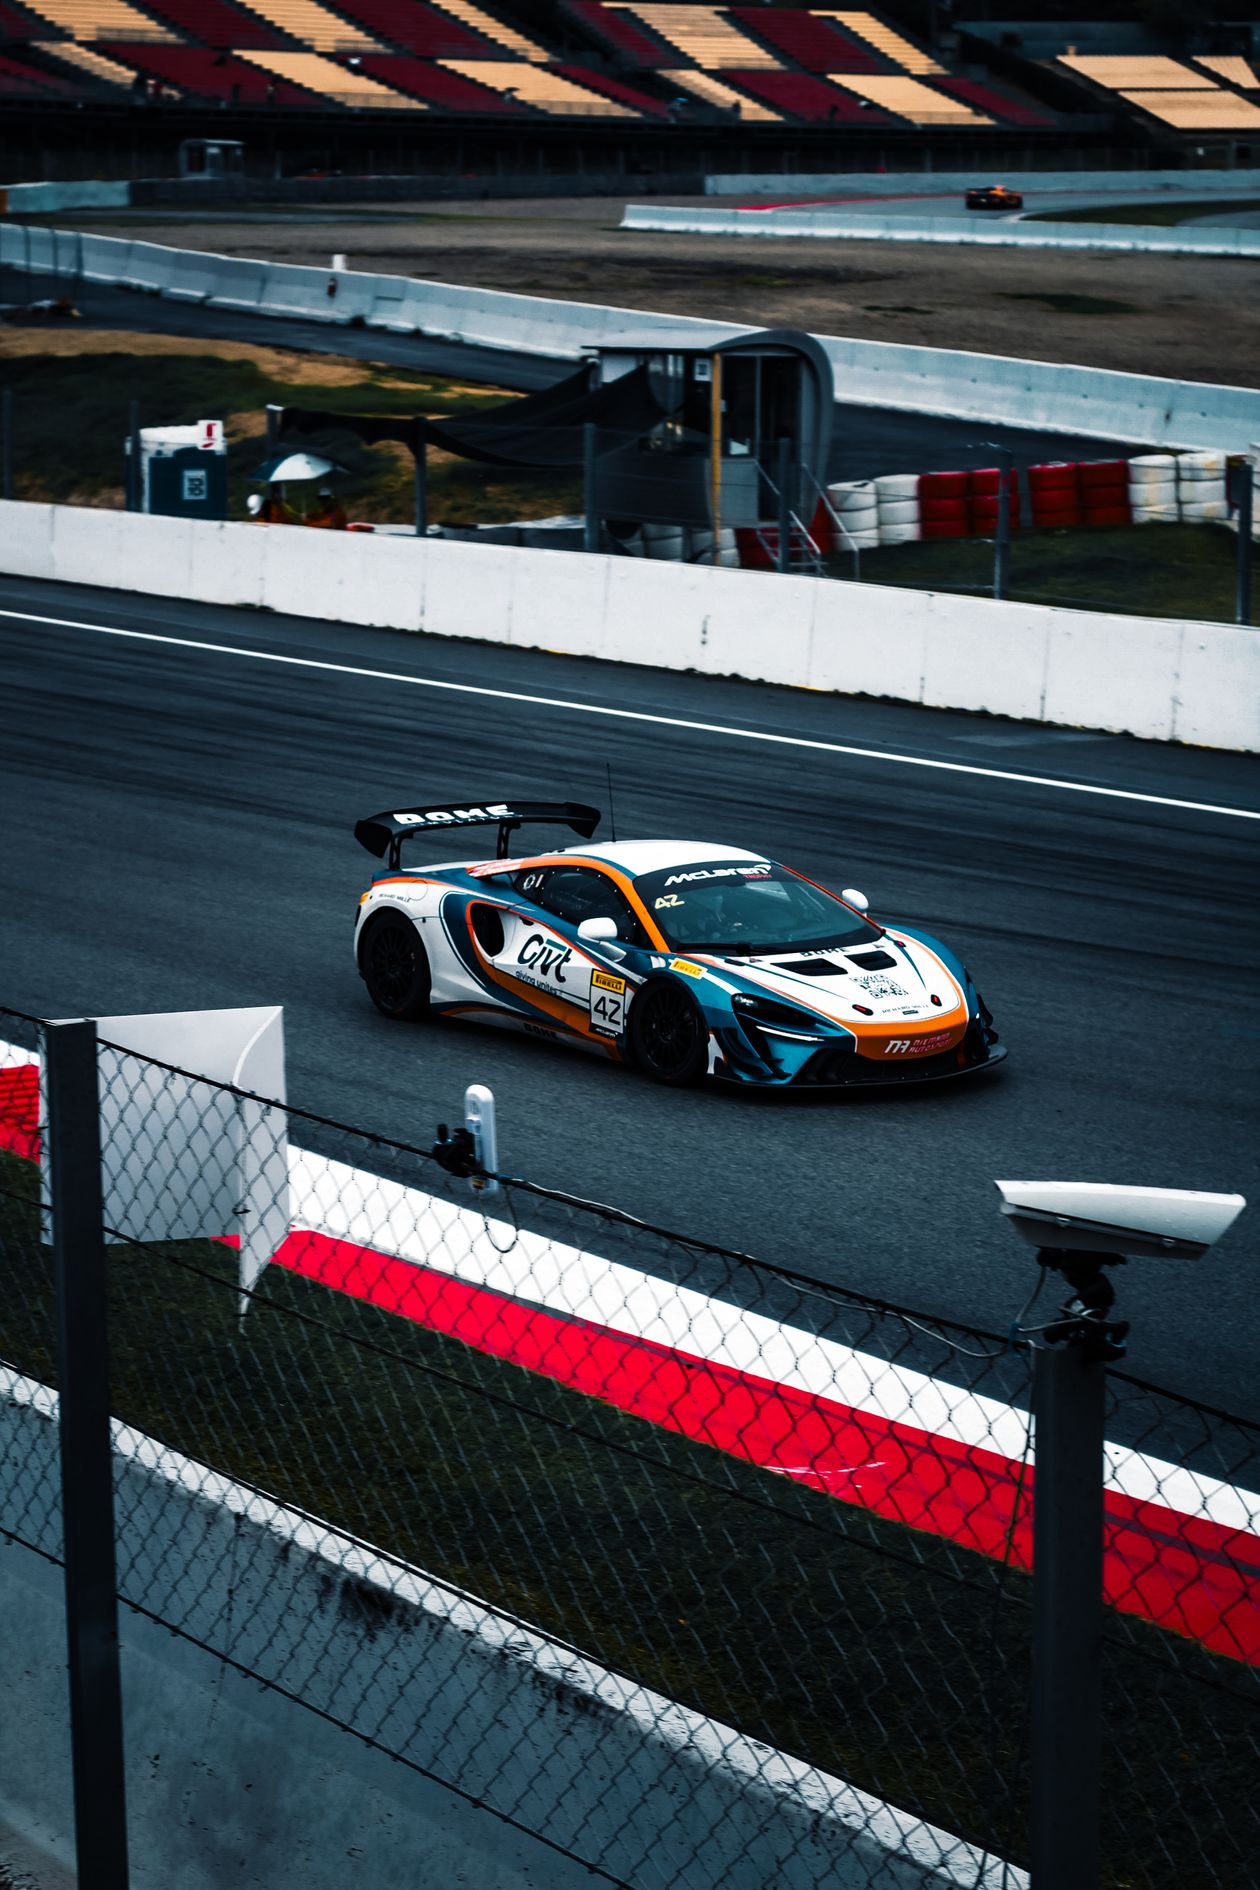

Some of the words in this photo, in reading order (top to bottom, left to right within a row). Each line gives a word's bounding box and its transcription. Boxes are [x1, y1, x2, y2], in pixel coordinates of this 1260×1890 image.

[393, 804, 514, 824] DOME
[664, 864, 772, 887] McLaren
[654, 894, 685, 910] 42
[673, 961, 702, 976] PIRELLI
[595, 973, 622, 991] PIRELLI
[593, 996, 621, 1025] 42
